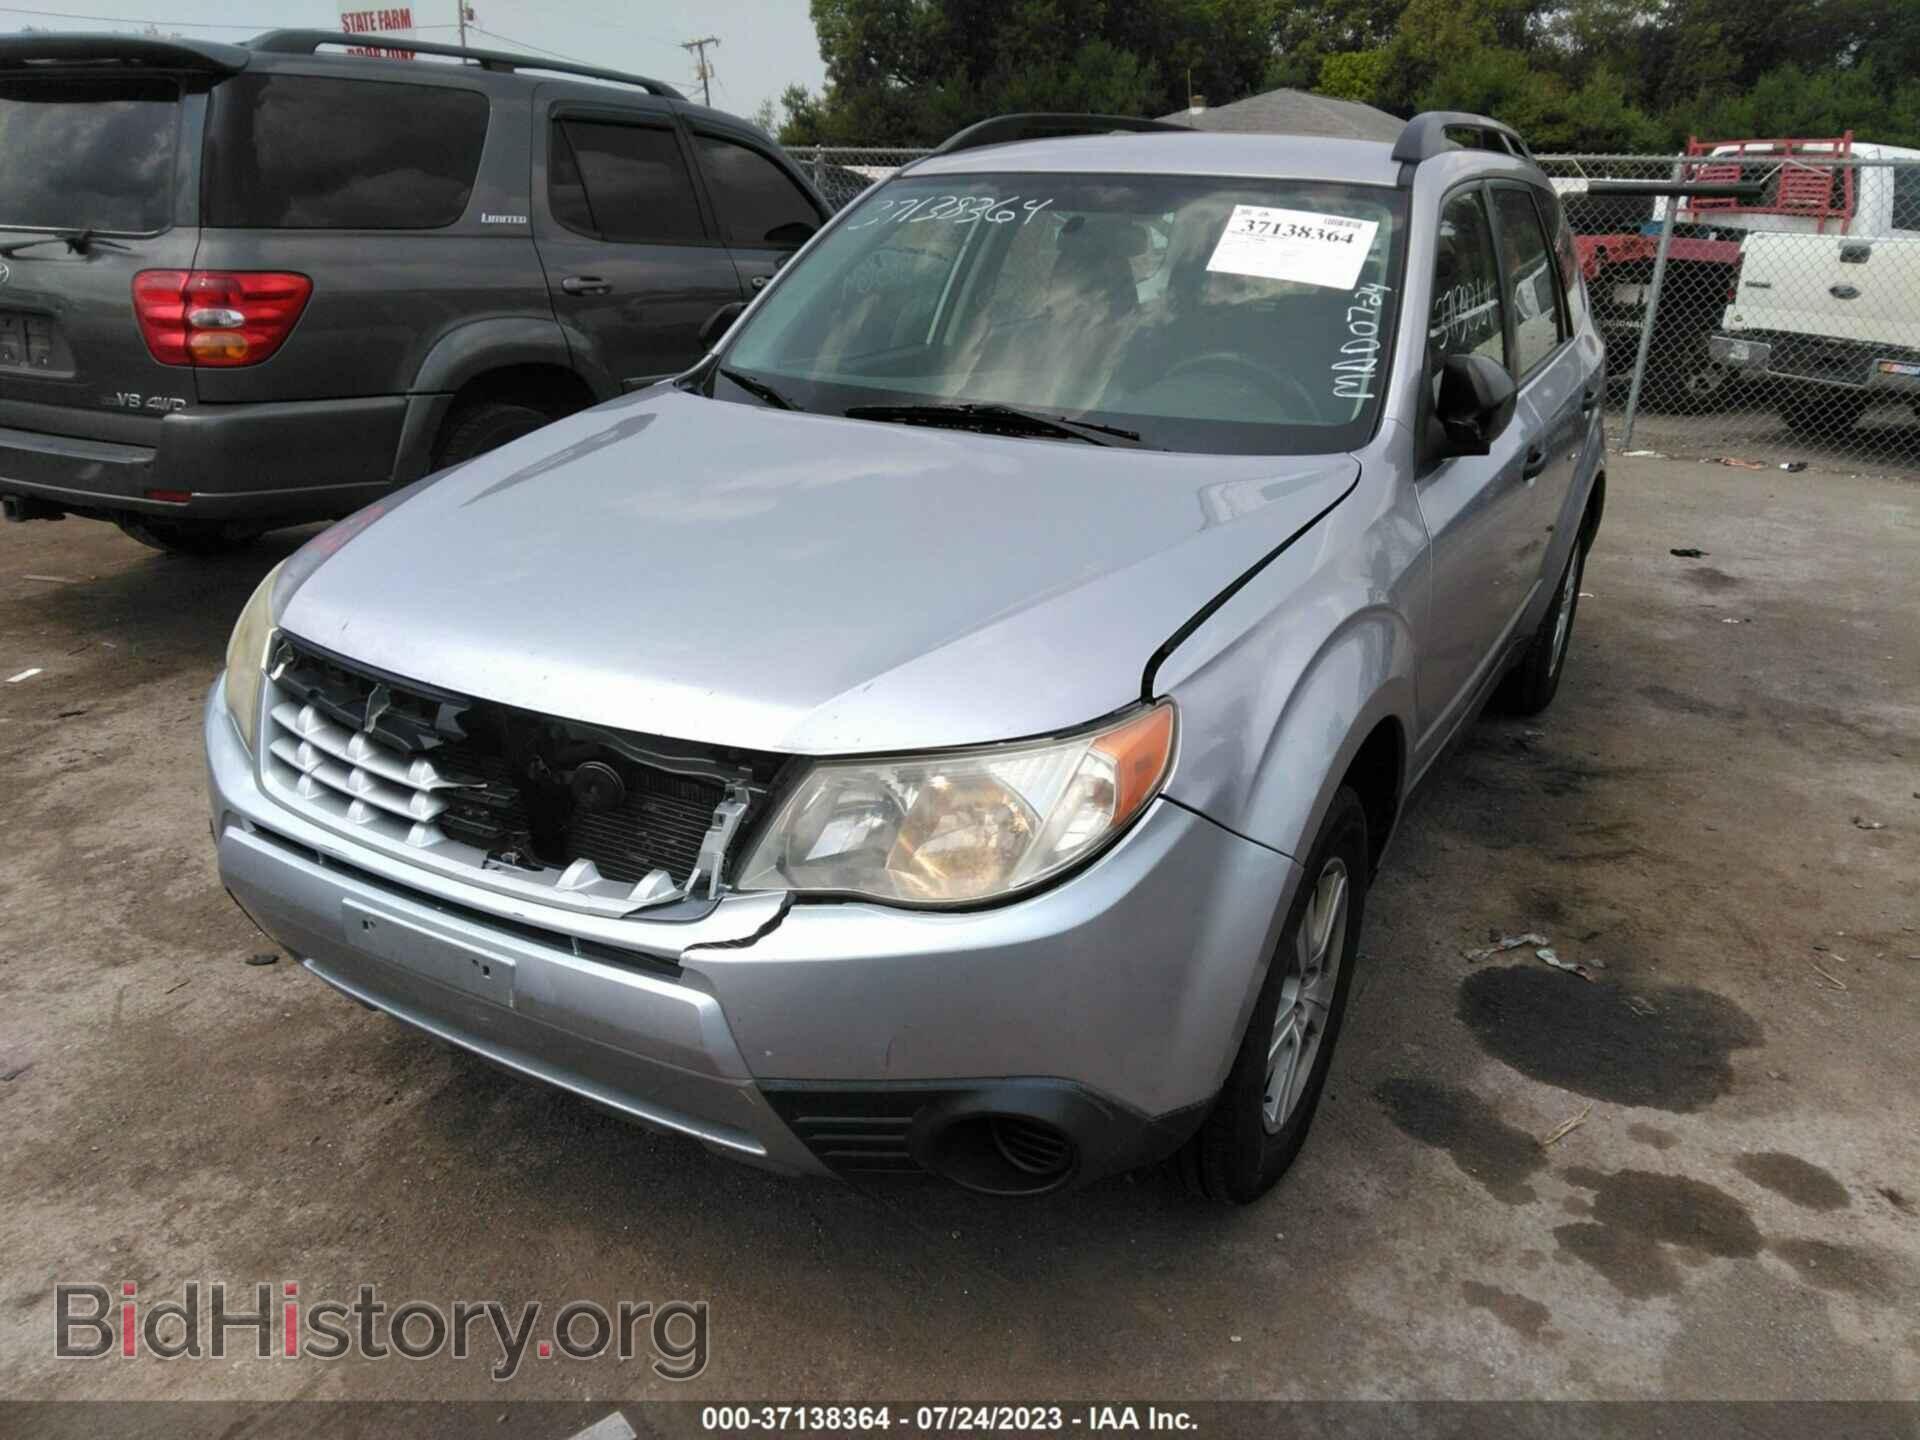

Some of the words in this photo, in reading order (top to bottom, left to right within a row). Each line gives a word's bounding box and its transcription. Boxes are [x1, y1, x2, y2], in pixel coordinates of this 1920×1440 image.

[341, 12, 377, 33] STATE
[378, 8, 412, 31] FARM
[848, 196, 1054, 230] 37138364
[1240, 219, 1354, 244] 37138364
[146, 396, 186, 411] 4WD
